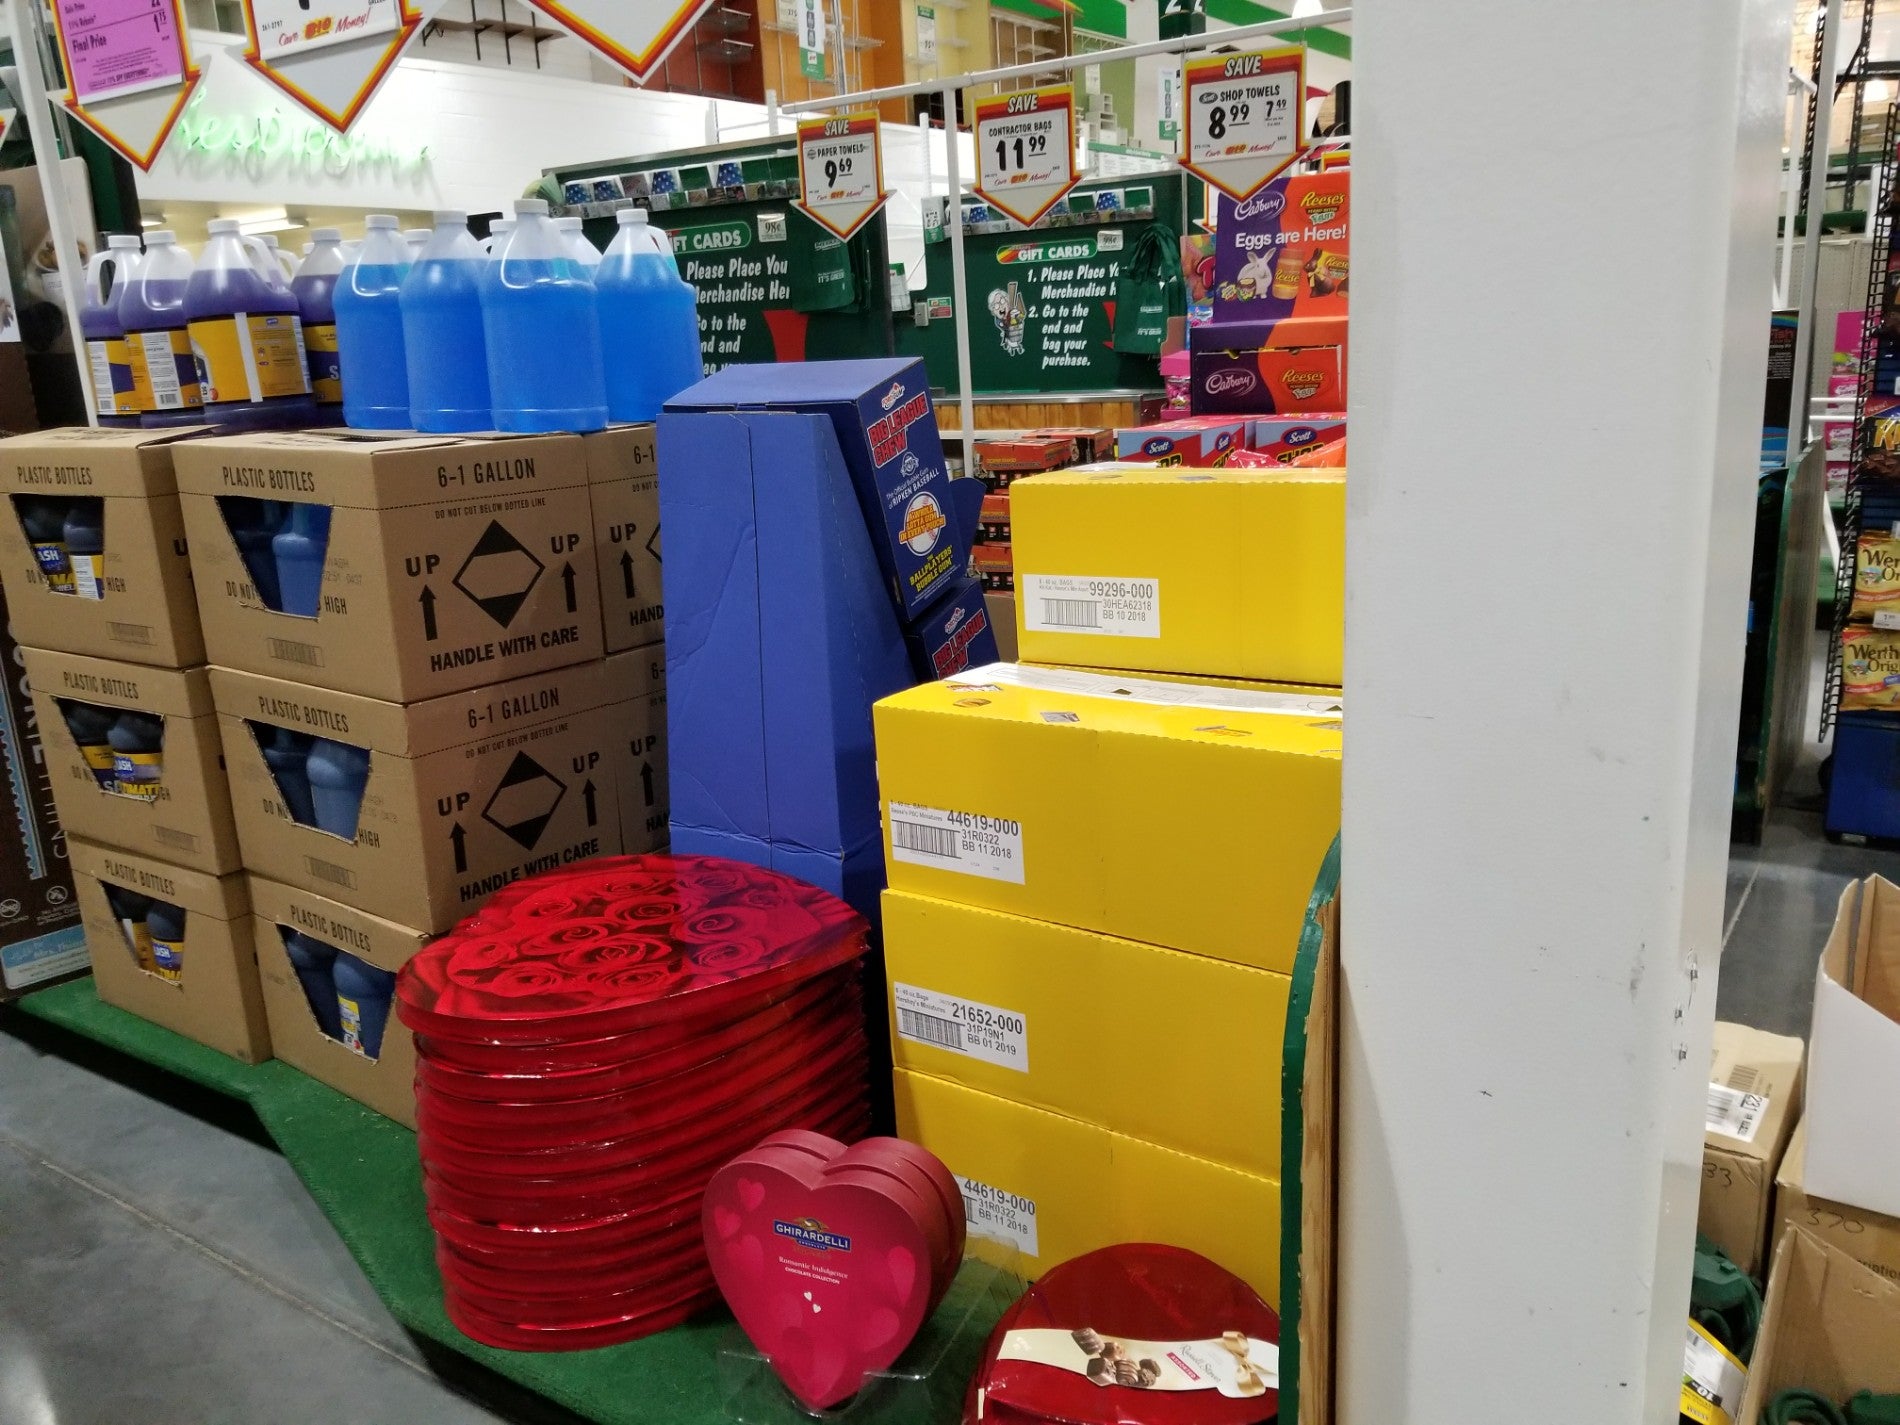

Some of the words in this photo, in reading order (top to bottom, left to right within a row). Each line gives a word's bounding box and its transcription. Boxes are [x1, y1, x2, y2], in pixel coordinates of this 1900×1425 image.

[335, 7, 371, 33] Money!
[72, 35, 89, 53] Final
[90, 33, 107, 49] Price
[1225, 55, 1262, 77] SAVE
[1008, 94, 1038, 113] SAVE
[1220, 88, 1243, 102] SHOP
[1246, 85, 1280, 99] TOWELS
[825, 119, 849, 136] SAVE
[989, 124, 1031, 137] CONTRACTOR
[1034, 120, 1052, 131] BAGS
[817, 146, 837, 157] PAPER
[839, 143, 864, 155] TOWELS
[1236, 196, 1281, 220] Cadbury
[693, 230, 741, 249] CARDS
[1236, 232, 1272, 250] Eggs
[1276, 232, 1300, 245] are
[1304, 224, 1346, 242] Here!
[1018, 247, 1044, 262] GIFT
[1049, 245, 1089, 259] CARDS
[687, 261, 724, 281] Please
[728, 256, 761, 277] Place
[766, 254, 788, 274] You
[1041, 265, 1073, 282] Please
[1077, 265, 1105, 280] Place
[770, 280, 789, 300] He
[1041, 283, 1106, 300] Merchandise
[1028, 306, 1038, 318] 2.
[1042, 305, 1056, 318] Go
[1059, 304, 1068, 317] to
[1072, 303, 1089, 317] the
[711, 315, 723, 330] to
[727, 312, 746, 331] the
[1042, 321, 1060, 334] end
[1064, 320, 1083, 334] and
[700, 335, 715, 353] nd
[719, 335, 741, 353] and
[1042, 338, 1060, 352] bag
[1064, 339, 1087, 351] your
[1042, 353, 1090, 370] purchase.
[1206, 373, 1251, 394] Cadbury
[868, 418, 889, 446] BIG
[886, 392, 929, 437] LEAGUE
[1149, 439, 1169, 454] Scott
[1288, 430, 1311, 443] Scott
[633, 444, 654, 465] 6-1
[873, 430, 907, 468] CHEW
[17, 466, 52, 484] PLASTIC
[54, 467, 93, 485] BOTTLES
[222, 466, 266, 488] PLASTIC
[270, 469, 315, 492] BOTTLES
[437, 465, 465, 488] 6-1
[473, 458, 536, 484] GALLON
[893, 488, 913, 507] RIPKEN
[913, 468, 940, 491] BASEBALL
[435, 509, 445, 519] DO
[448, 507, 461, 518] NOT
[464, 505, 477, 515] CUT
[479, 502, 503, 514] BELOW
[505, 499, 529, 511] DOTTED
[532, 497, 546, 508] LINE
[609, 522, 636, 544] UP
[551, 533, 580, 555] UP
[405, 555, 440, 577] UP
[106, 577, 127, 592] HIGH
[226, 581, 237, 597] DO
[915, 569, 939, 593] BUBBLE
[1089, 581, 1153, 599] 99296-000
[324, 596, 347, 615] HIGH
[629, 604, 664, 626] HAND
[1103, 600, 1152, 611] 30HEA62318
[1103, 610, 1114, 619] BB
[1117, 611, 1125, 620] 10
[1128, 611, 1146, 621] 2018
[950, 608, 987, 659] LEAGUE
[431, 643, 495, 673] HANDLE
[498, 634, 536, 658] WITH
[540, 626, 579, 649] CARE
[1849, 644, 1899, 659] Werth
[1868, 659, 1900, 674] Orig
[64, 671, 99, 693] PLASTIC
[100, 678, 139, 699] BOTTLES
[258, 696, 301, 721] PLASTIC
[304, 706, 349, 733] BOTTLES
[468, 703, 494, 729] 6-1
[502, 687, 560, 719] GALLON
[506, 734, 528, 748] BELOW
[555, 722, 569, 734] LINE
[630, 734, 657, 756] UP
[573, 751, 600, 774] UP
[263, 798, 275, 815] DO
[437, 792, 471, 816] UP
[947, 810, 1018, 836] 44619-000
[358, 828, 380, 848] HIGH
[962, 829, 999, 845] 31R0322
[963, 840, 975, 851] BB
[978, 844, 988, 854] 11
[991, 845, 1012, 859] 2018
[104, 859, 137, 883] PLASTIC
[140, 870, 175, 896] BOTTLES
[460, 866, 520, 902] HANDLE
[524, 854, 560, 879] WITH
[563, 838, 599, 864] CARE
[290, 904, 328, 934] PLASTIC
[330, 922, 371, 952] BOTTLES
[952, 1002, 1022, 1034] 21652-000
[967, 1023, 1004, 1041] 31P19N1
[968, 1034, 980, 1045] BB
[983, 1037, 992, 1048] 01
[995, 1041, 1016, 1055] 2019
[964, 1179, 1035, 1215] 44619-000
[979, 1198, 1015, 1219] 31R0322
[979, 1208, 991, 1220] BB
[995, 1214, 1003, 1225] 11
[1007, 1219, 1028, 1234] 2018
[776, 1224, 848, 1248] GHIRARDELLI
